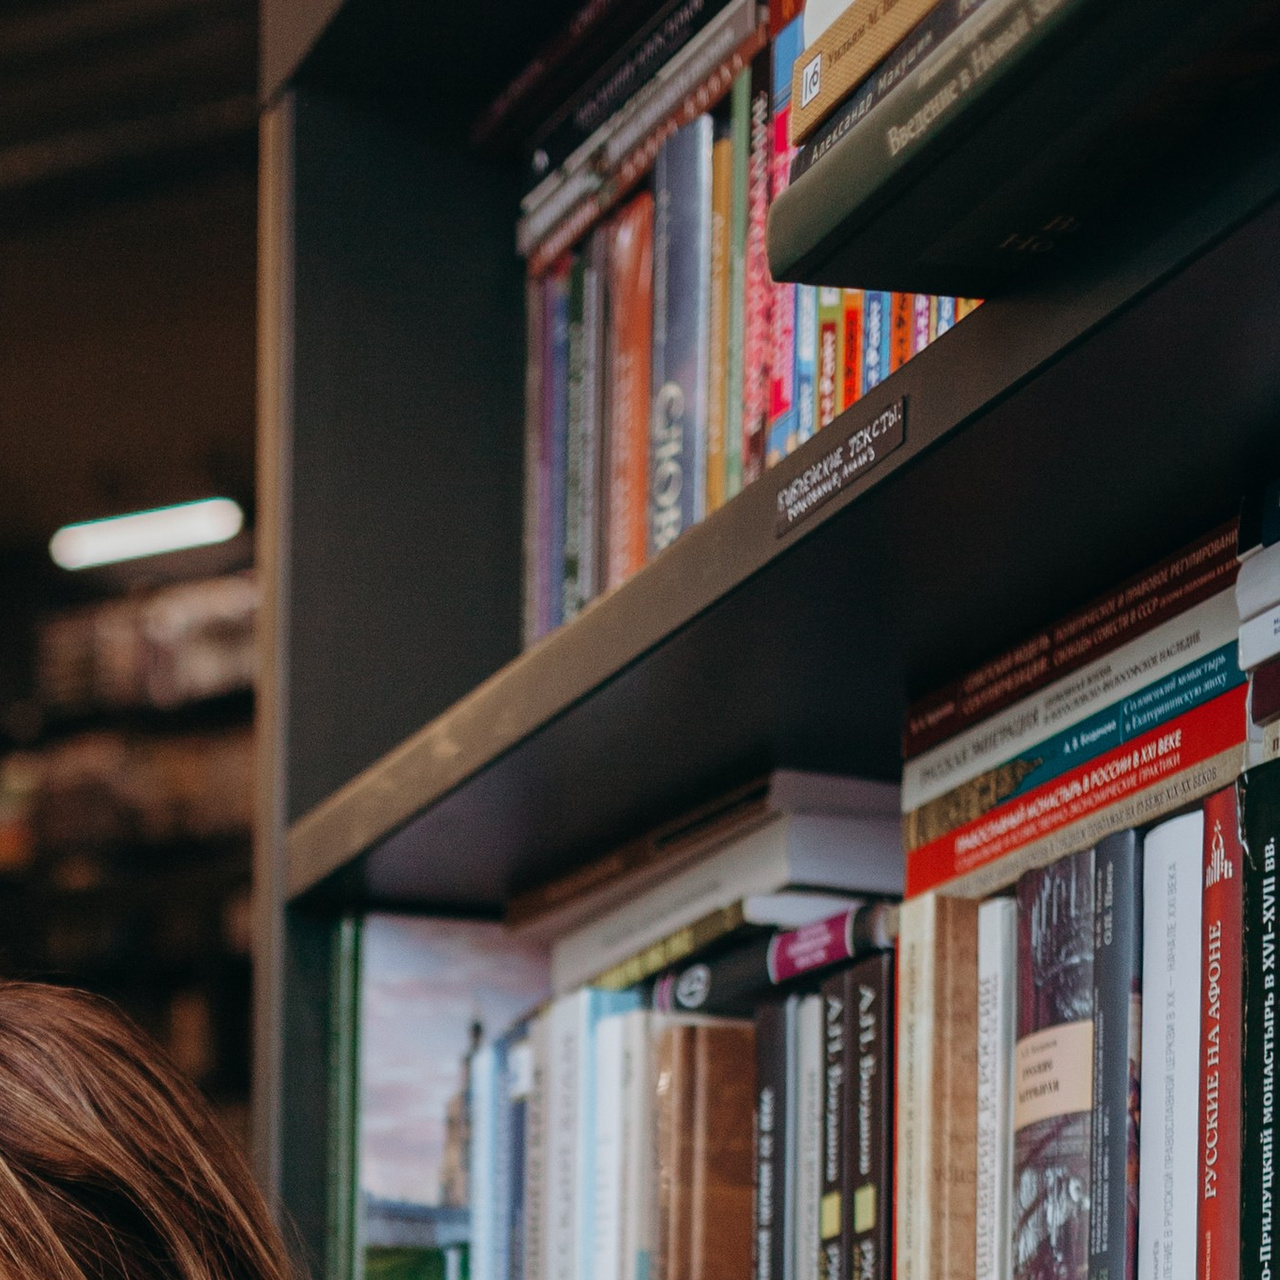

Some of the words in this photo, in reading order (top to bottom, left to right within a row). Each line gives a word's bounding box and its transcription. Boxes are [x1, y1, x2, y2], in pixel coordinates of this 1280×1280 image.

[811, 92, 874, 165] Александр
[1158, 729, 1182, 757] ВЕКЕ
[1168, 862, 1177, 892] ВЕКА
[1167, 921, 1177, 974] НАЧАЛЕ
[1207, 920, 1223, 1021] АФОНЕ
[1165, 1023, 1176, 1071] ЦЕРКВИ
[1206, 1023, 1221, 1066] НА
[1164, 1073, 1175, 1169] ПРАВОСЛАВНОЙ
[1204, 1070, 1220, 1200] РУССКИЕ
[1163, 1172, 1174, 1226] РУССКОЙ
